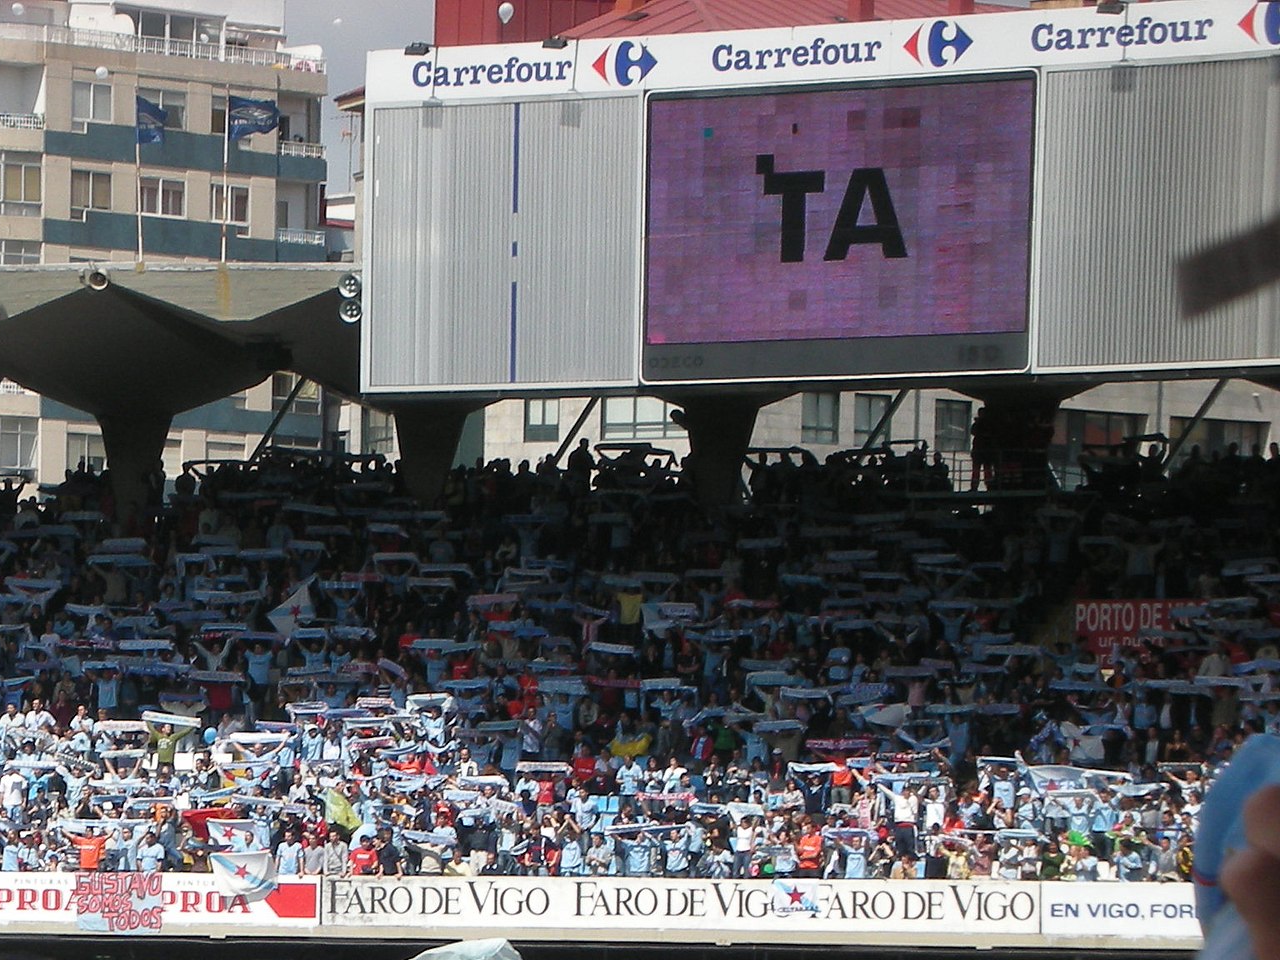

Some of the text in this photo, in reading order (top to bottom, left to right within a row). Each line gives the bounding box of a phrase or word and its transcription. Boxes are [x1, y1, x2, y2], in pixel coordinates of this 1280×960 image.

[1031, 17, 1214, 53] Carrefour
[412, 56, 572, 87] Carrefour
[711, 37, 882, 73] Carrefour
[763, 166, 908, 262] TA
[1075, 602, 1134, 631] PORTO
[1140, 603, 1163, 629] DE
[75, 872, 163, 898] GUSTAVO
[327, 881, 550, 917] FARO DE VIGO
[575, 882, 658, 917] FARO
[665, 888, 707, 917] DE
[76, 894, 132, 914] SOMOS
[902, 889, 944, 920] DE
[949, 884, 1034, 921] VIGO
[1051, 903, 1078, 918] EN
[103, 910, 162, 931] TODOS
